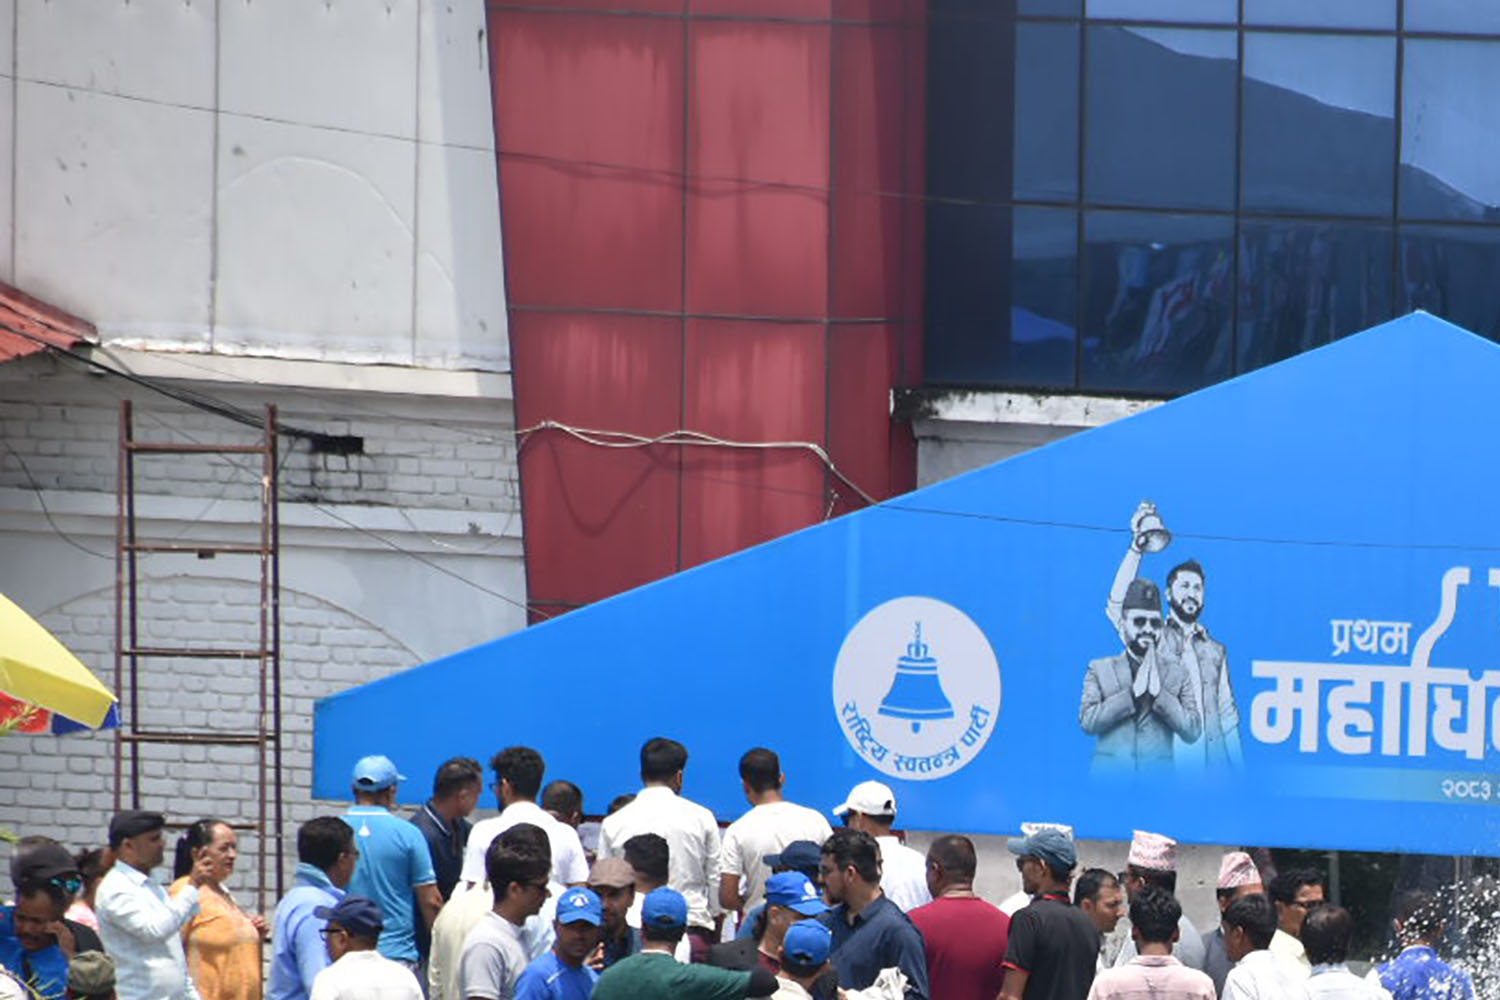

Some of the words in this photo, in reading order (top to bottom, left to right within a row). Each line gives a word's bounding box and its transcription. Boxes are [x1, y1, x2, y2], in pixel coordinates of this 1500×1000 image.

[1330, 619, 1411, 658] प्रथम
[843, 701, 887, 761] राष्ट्रिय
[893, 745, 961, 774] स्वतन्त्र
[960, 703, 991, 749] पार्टी
[1441, 779, 1492, 801] २०८३
